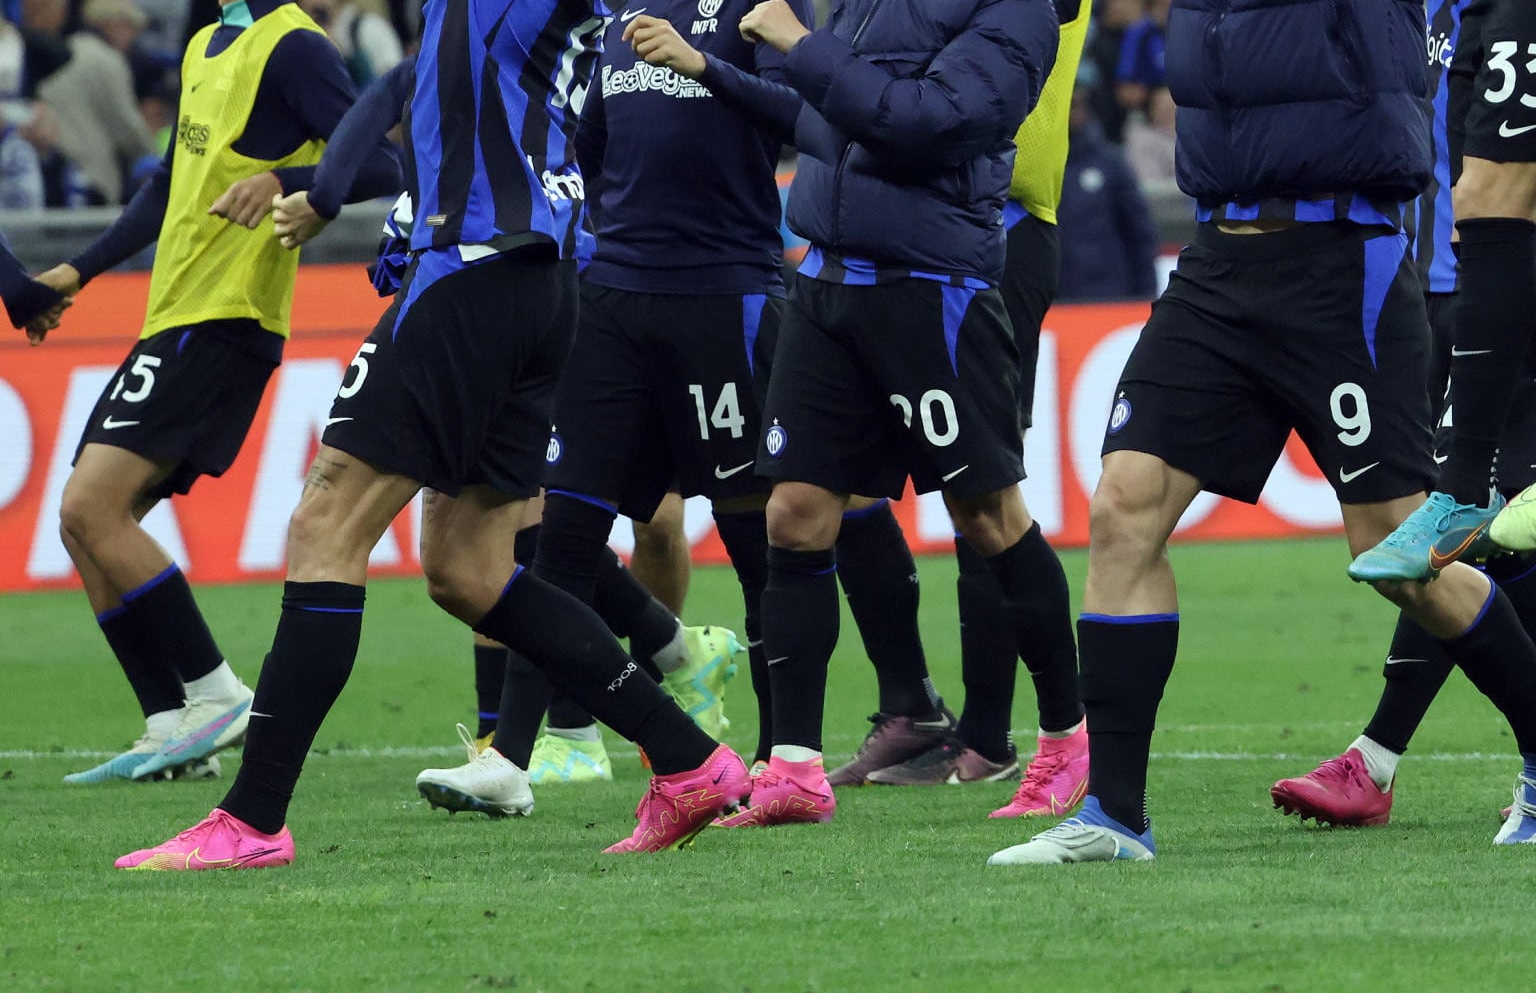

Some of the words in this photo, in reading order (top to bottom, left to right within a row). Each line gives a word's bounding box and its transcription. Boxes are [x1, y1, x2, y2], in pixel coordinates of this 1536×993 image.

[688, 381, 745, 440] 14
[1329, 382, 1372, 447] 9
[607, 661, 638, 692] 1908
